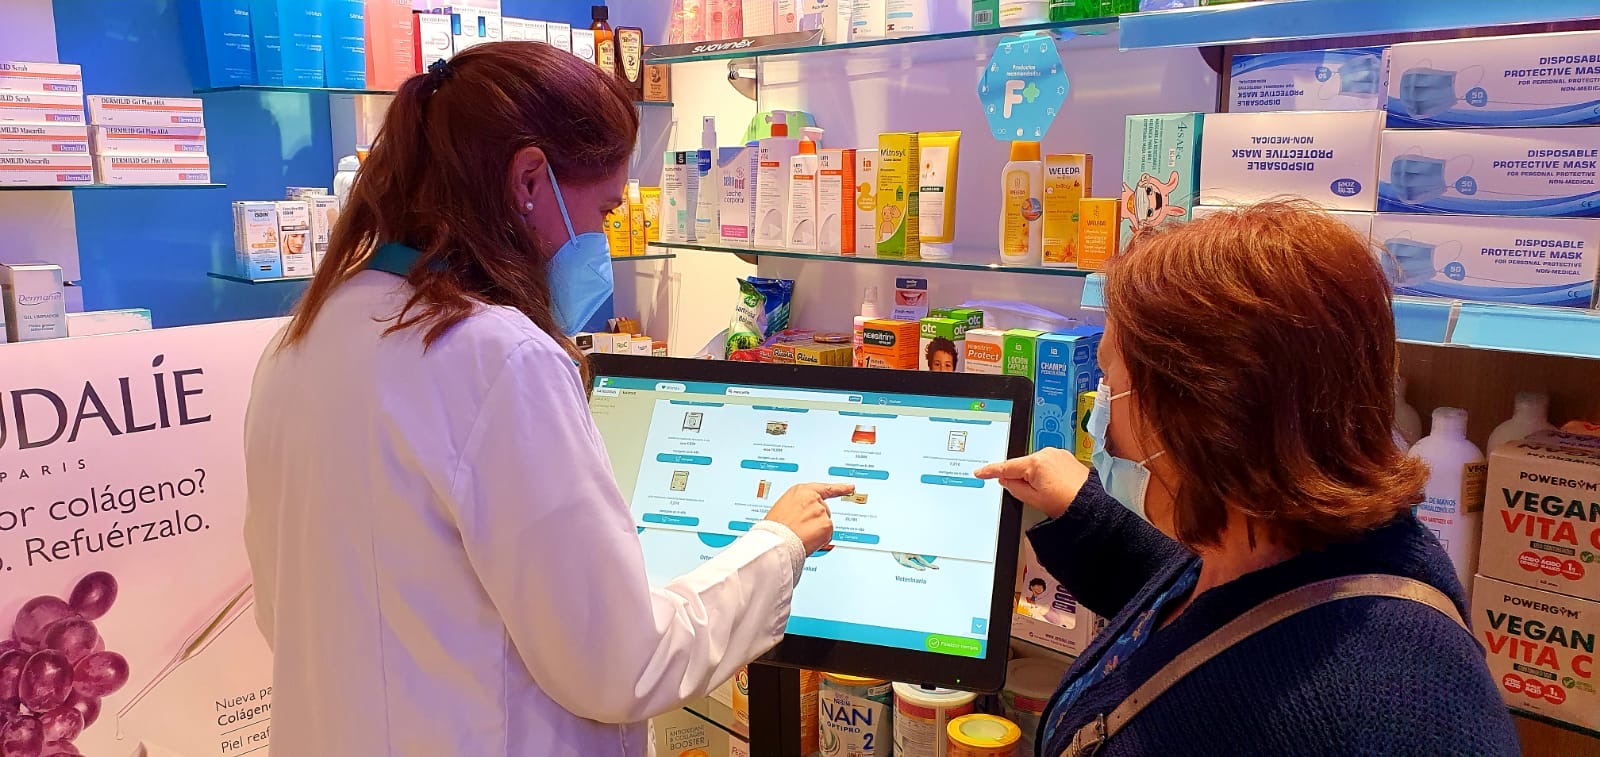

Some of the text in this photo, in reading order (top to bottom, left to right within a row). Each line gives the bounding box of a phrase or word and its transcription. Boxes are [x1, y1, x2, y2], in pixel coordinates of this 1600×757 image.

[1504, 67, 1571, 77] PROTECTIVE
[101, 97, 131, 105] DERMILID
[1237, 99, 1281, 107] DISPOSABLE
[1251, 136, 1314, 144] NON-MEDICAL
[881, 148, 906, 157] Mitosyl
[1232, 149, 1333, 159] PROTECTIVE MASK
[1528, 149, 1598, 157] DISPOSABLE
[1247, 161, 1314, 171] DISPOSABLE
[1493, 160, 1597, 169] PROTECTIVE MASK
[1048, 167, 1080, 175] WELEDA
[1515, 239, 1584, 249] DISPOSABLE
[1481, 248, 1583, 260] PROTECTIVE MASK
[968, 315, 981, 326] otc
[921, 323, 937, 334] otc
[954, 325, 967, 336] otc
[774, 348, 794, 359] Ricola
[968, 349, 999, 361] Protect
[1051, 347, 1058, 355] ia
[797, 353, 818, 363] Ricola
[1041, 361, 1067, 371] CHAMPÚ
[1519, 471, 1597, 491] POWERGYM
[49, 468, 206, 522] colágeno?
[1437, 498, 1457, 506] MANOS
[1500, 509, 1579, 546] VITA
[26, 510, 210, 567] Refuérzalo.
[895, 575, 927, 584] Veterinaria
[1503, 594, 1578, 619] POWERGYM
[1486, 608, 1595, 653] VEGAN
[1485, 631, 1560, 671] VITA
[1571, 654, 1593, 679] C
[215, 692, 256, 712] Nueva
[822, 697, 872, 726] NAN
[827, 721, 860, 734] OPTIPRO
[221, 735, 243, 754] Piel
[671, 737, 705, 750] BOOSTER
[863, 733, 874, 750] 2
